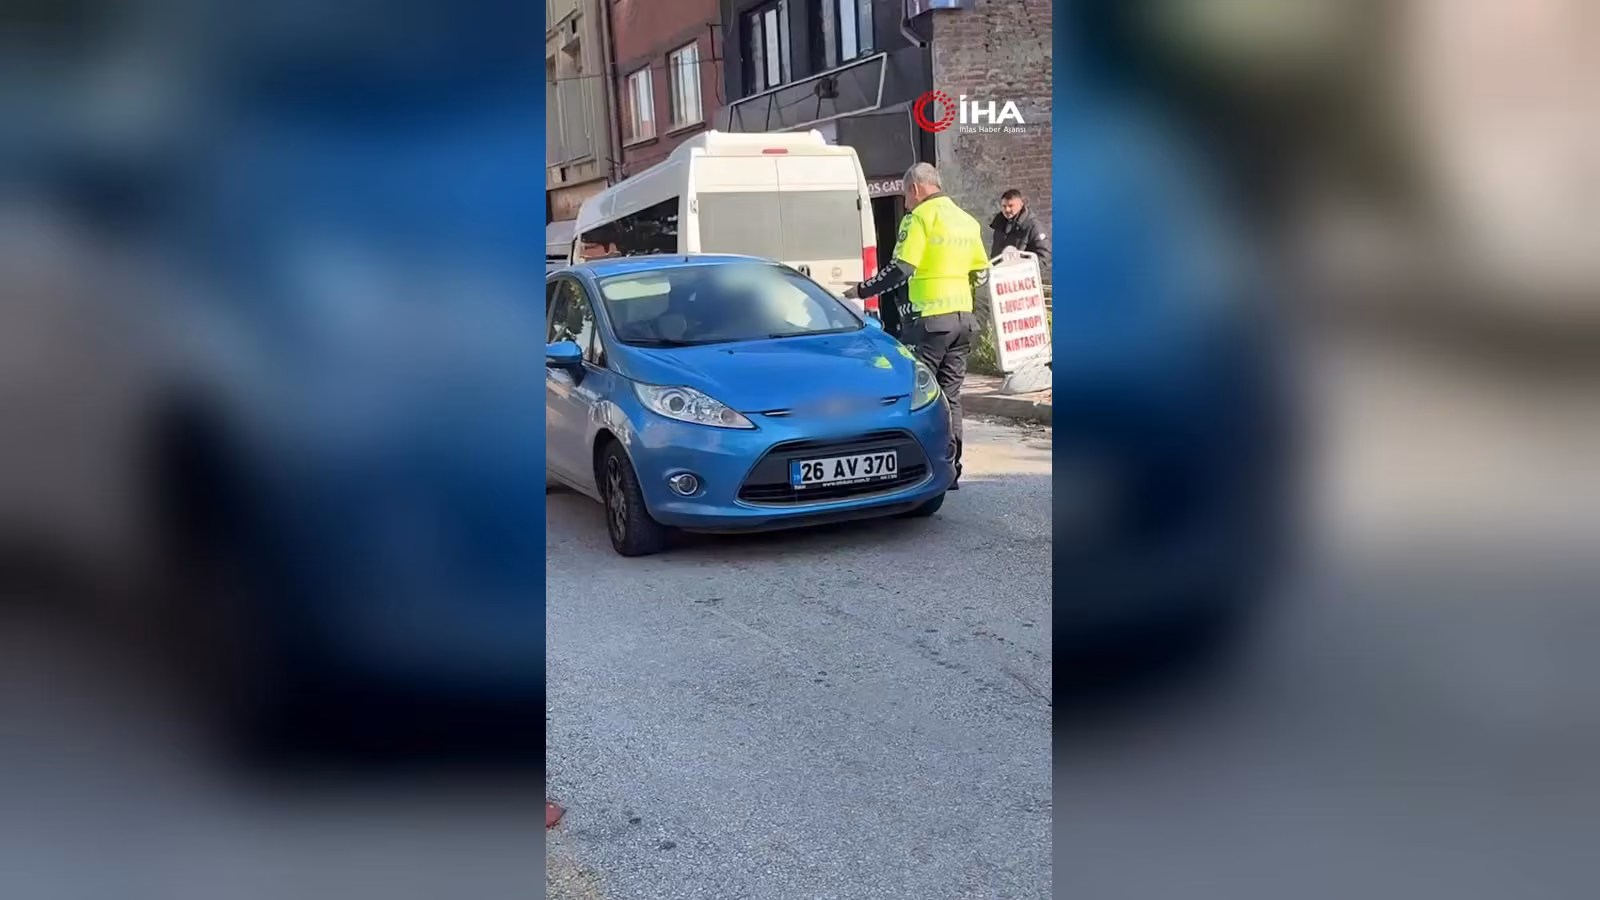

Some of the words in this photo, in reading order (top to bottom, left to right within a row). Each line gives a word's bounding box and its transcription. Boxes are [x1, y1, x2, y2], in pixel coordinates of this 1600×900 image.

[802, 462, 824, 482] 26
[833, 458, 859, 478] AV
[864, 454, 896, 474] 370
